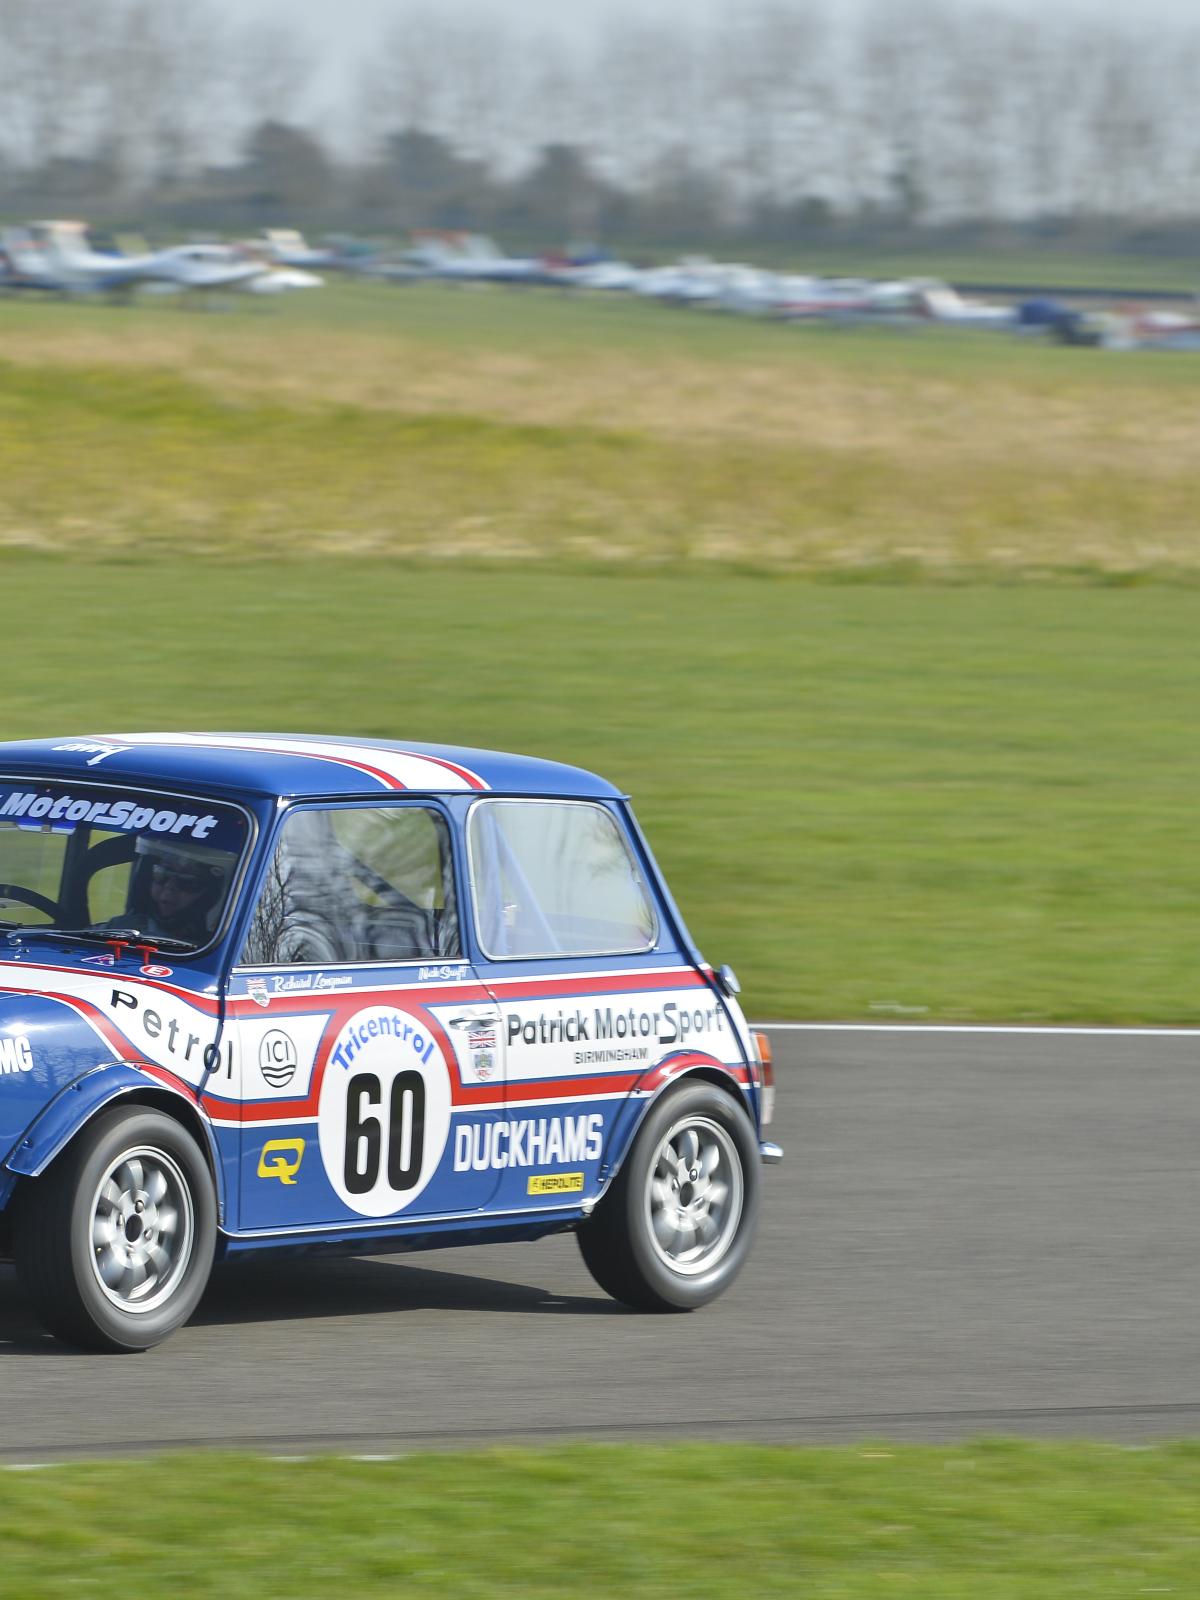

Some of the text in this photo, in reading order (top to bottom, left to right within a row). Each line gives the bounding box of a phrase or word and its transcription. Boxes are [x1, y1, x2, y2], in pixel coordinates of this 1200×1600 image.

[110, 989, 233, 1079] Petrol
[266, 1040, 290, 1063] ICI
[330, 1014, 435, 1071] Tricentrol
[506, 1001, 725, 1046] Patrick MotorSport
[574, 1047, 648, 1064] BIRMINGHAM
[344, 1069, 426, 1195] 60
[453, 1113, 604, 1172] DUCKHAMS
